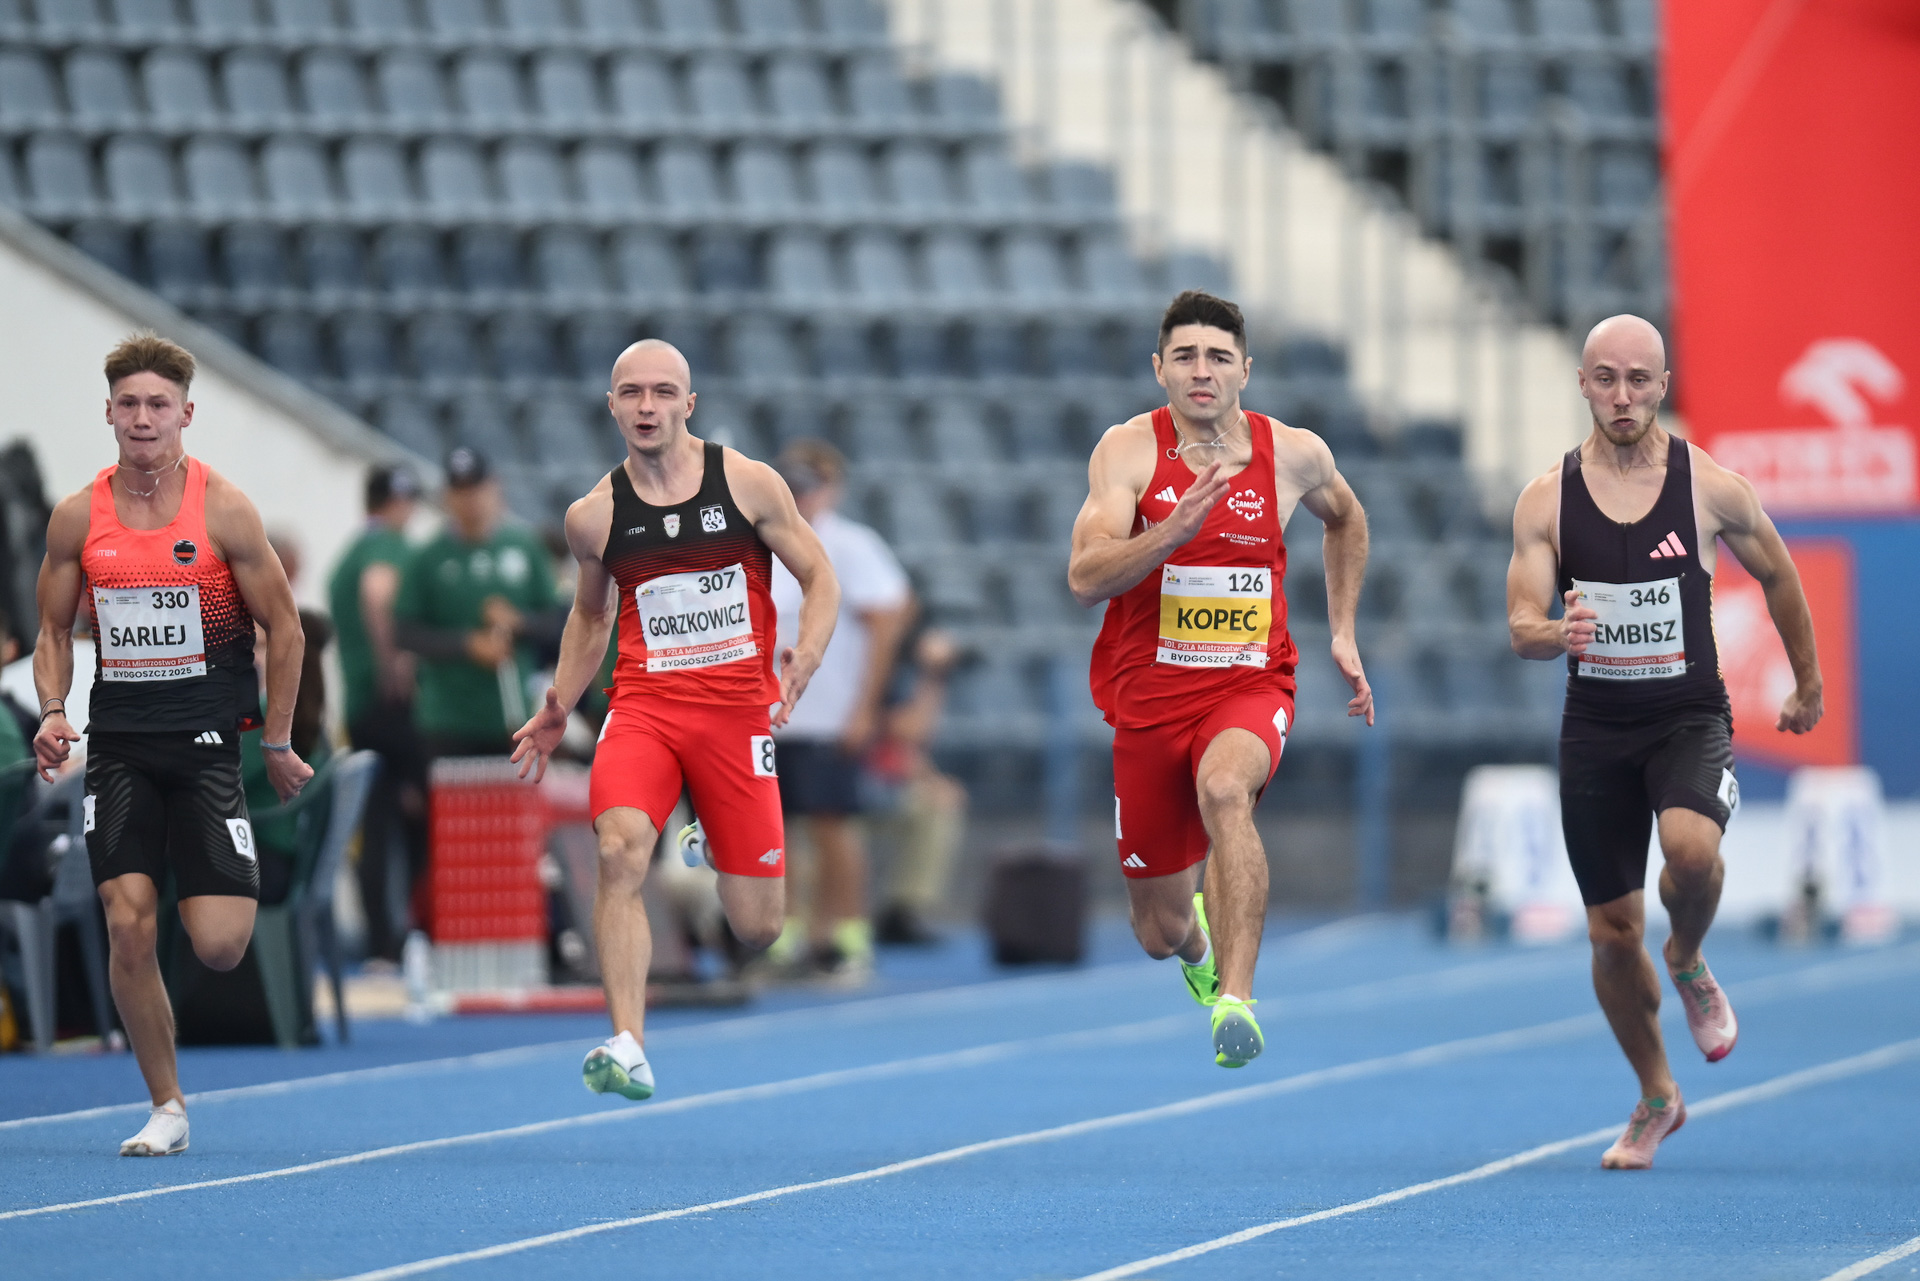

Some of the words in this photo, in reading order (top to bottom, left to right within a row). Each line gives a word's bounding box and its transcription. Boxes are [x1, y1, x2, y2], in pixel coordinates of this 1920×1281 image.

[1235, 500, 1262, 510] ZAMOŚĆ
[698, 570, 736, 594] 307
[1228, 573, 1264, 593] 126
[151, 591, 190, 609] 330
[1629, 585, 1671, 607] 346
[649, 602, 746, 637] GORZKOWICZ
[1177, 605, 1258, 632] KOPEĆ
[110, 624, 187, 647] SARLEJ
[1594, 619, 1677, 645] EMBISZ
[666, 647, 684, 657] PZLA
[685, 641, 728, 655] Mistrzostwa
[728, 635, 750, 646] Polski
[1177, 643, 1196, 651] PZLA
[117, 660, 132, 668] PZLA
[132, 657, 177, 668] Mistrzostwa
[177, 655, 200, 666] Polski
[661, 654, 720, 668] BYDGOSZCZ
[722, 648, 745, 660] 2025
[1170, 653, 1233, 663] BYDGOSZCZ
[1235, 653, 1252, 661] 25
[1595, 656, 1610, 664] PZLA
[1658, 653, 1679, 663] Polski
[113, 669, 167, 678] BYDGOSZCZ
[168, 667, 192, 676] 2025
[1591, 666, 1647, 676] BYDGOSZCZ
[1648, 665, 1673, 675] 2025
[761, 739, 774, 773] 8
[1728, 780, 1738, 810] 6
[236, 824, 249, 849] 9
